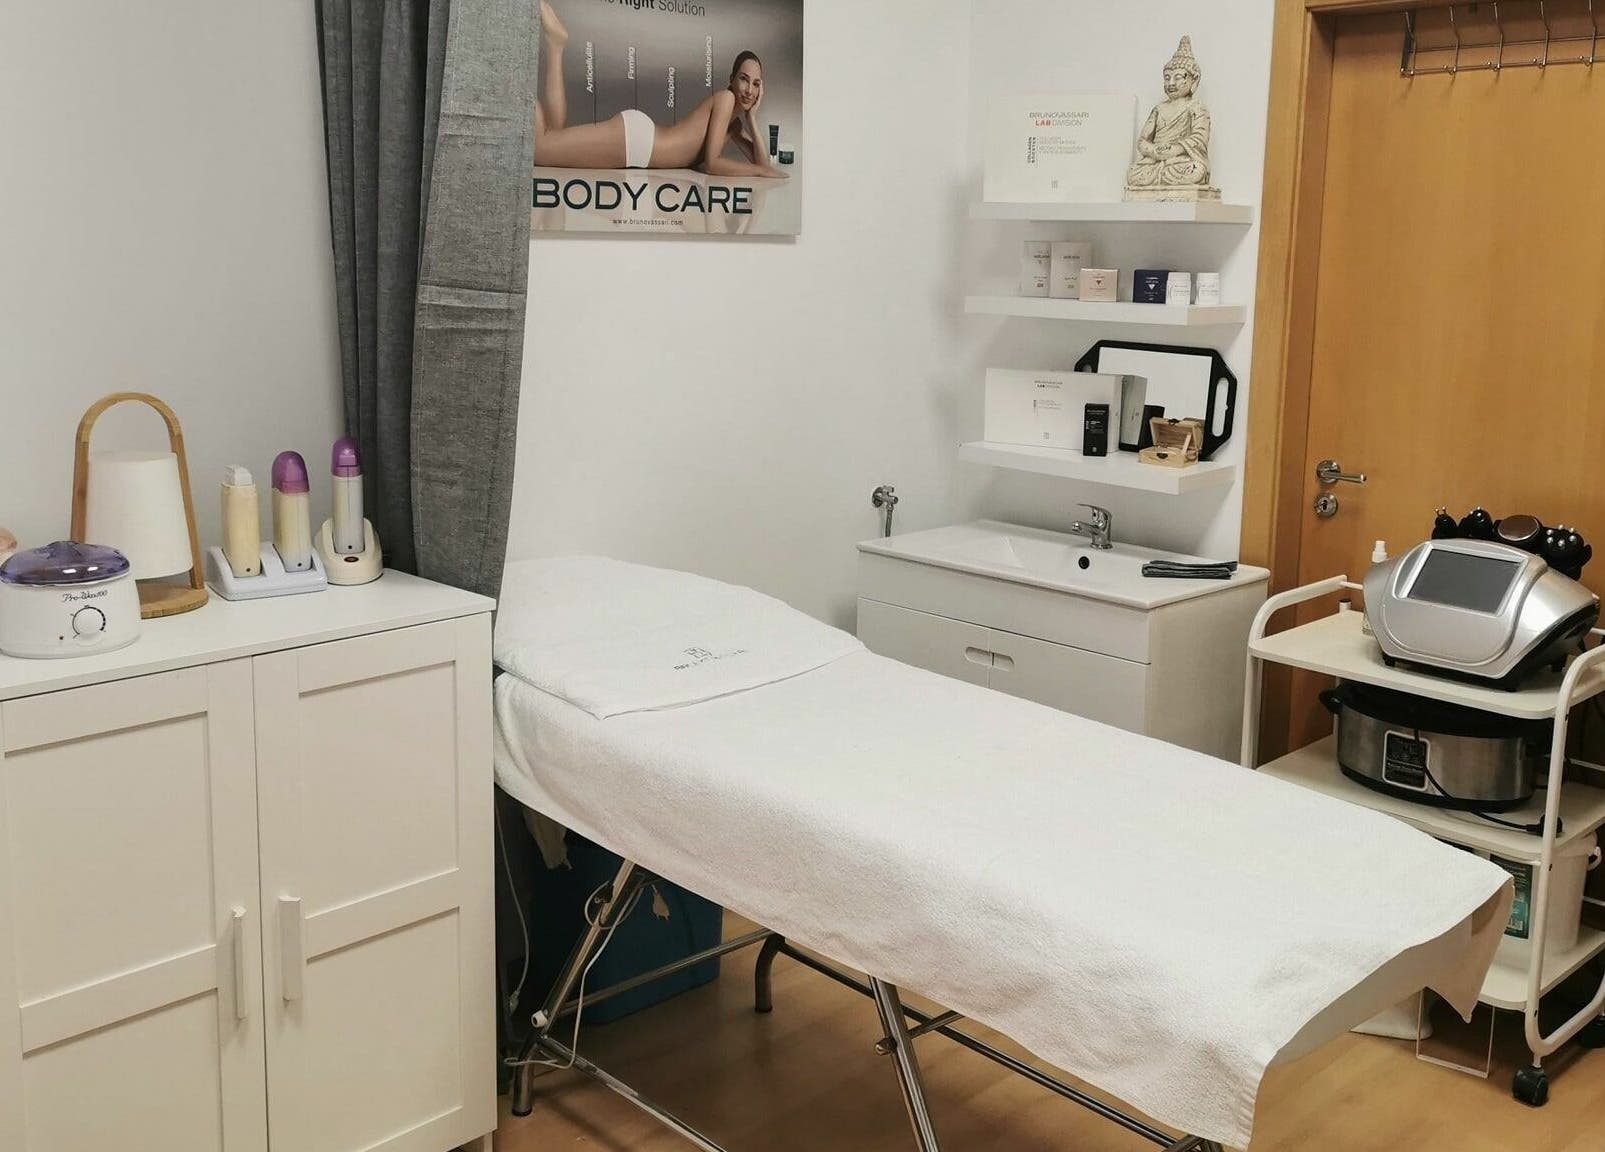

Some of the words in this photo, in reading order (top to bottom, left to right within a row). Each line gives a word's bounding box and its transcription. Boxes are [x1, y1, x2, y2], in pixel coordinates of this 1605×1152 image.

[658, 0, 705, 17] Solution
[585, 41, 593, 93] Anticellulite
[627, 46, 636, 80] Firming
[667, 67, 676, 108] Sculpting
[1035, 119, 1052, 127] LAB
[532, 178, 648, 211] BODY
[655, 183, 753, 214] CARE
